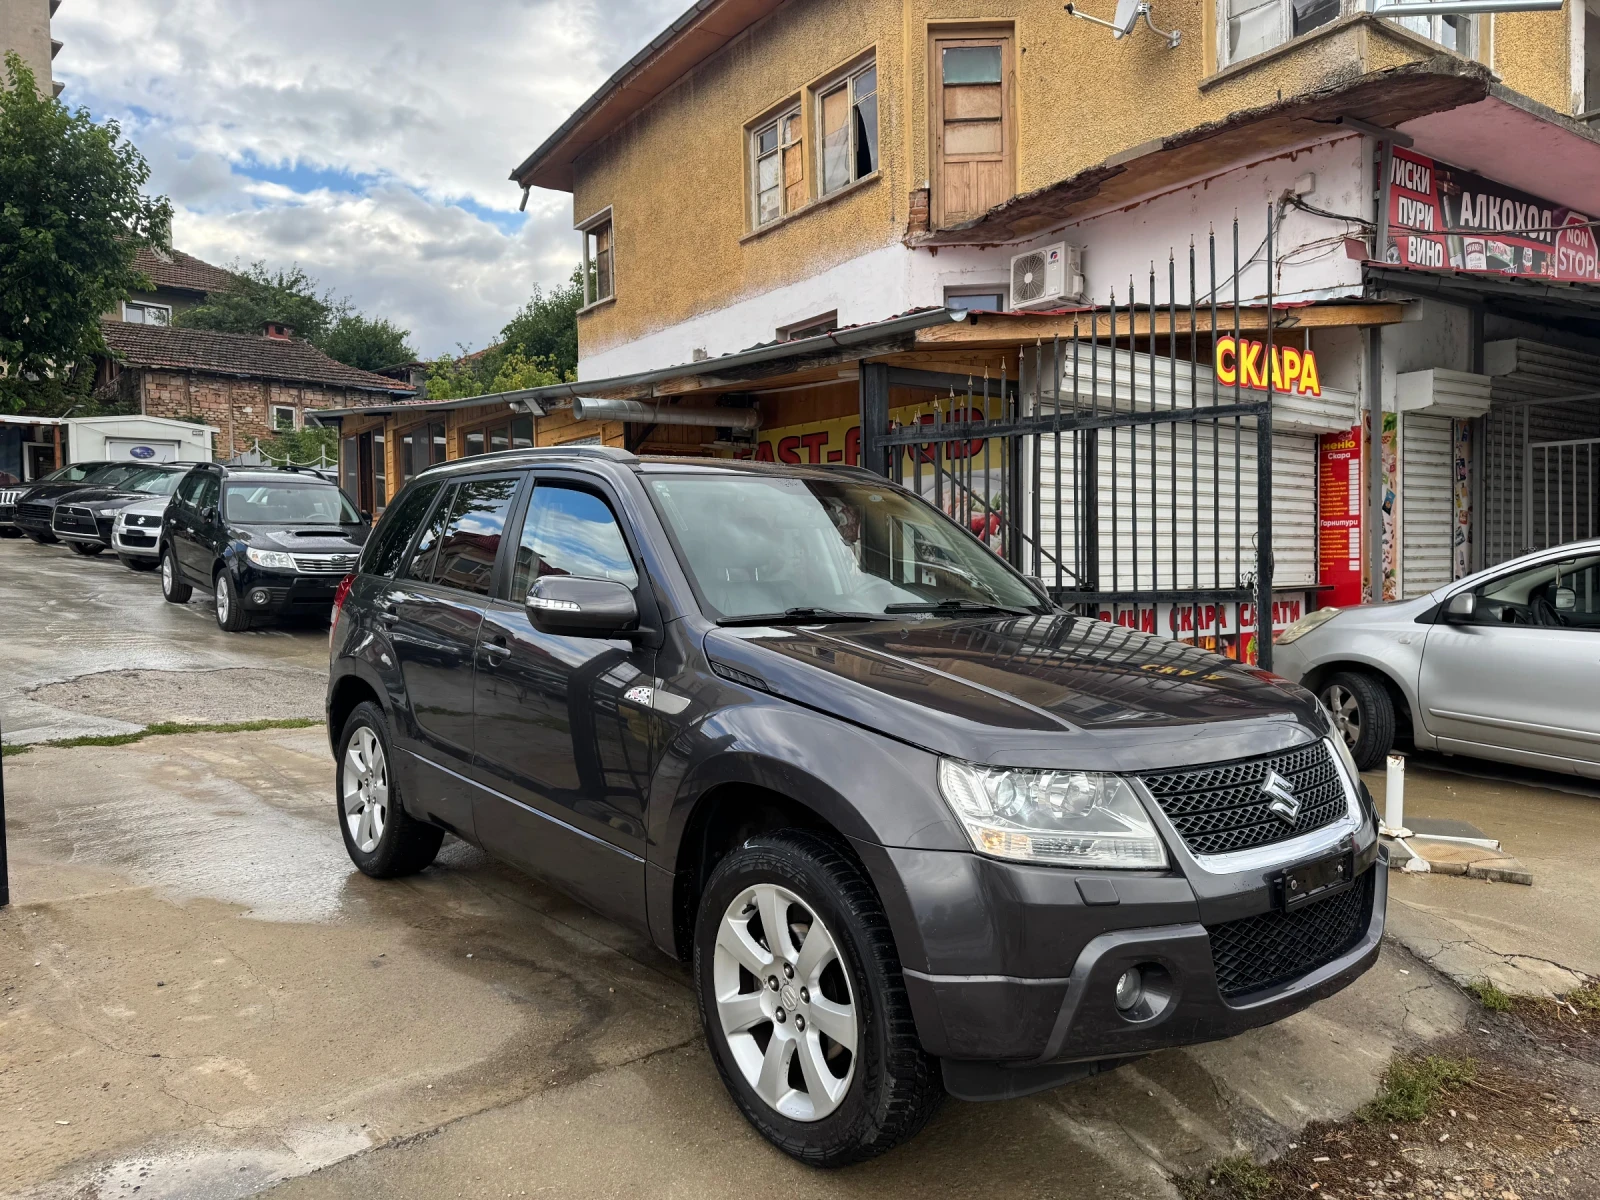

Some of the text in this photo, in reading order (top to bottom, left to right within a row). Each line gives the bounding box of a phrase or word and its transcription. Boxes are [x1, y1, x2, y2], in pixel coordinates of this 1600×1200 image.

[1398, 196, 1434, 231] ПУРИ
[1460, 191, 1551, 243] АЛКОХОЛ
[1408, 236, 1443, 267] ВИНО
[1566, 228, 1589, 249] NON
[1558, 247, 1595, 279] STOP
[1216, 336, 1321, 396] СКАРА
[1328, 452, 1351, 460] Скара
[1169, 604, 1227, 632] СКАРА
[1240, 600, 1300, 627] СААТИ
